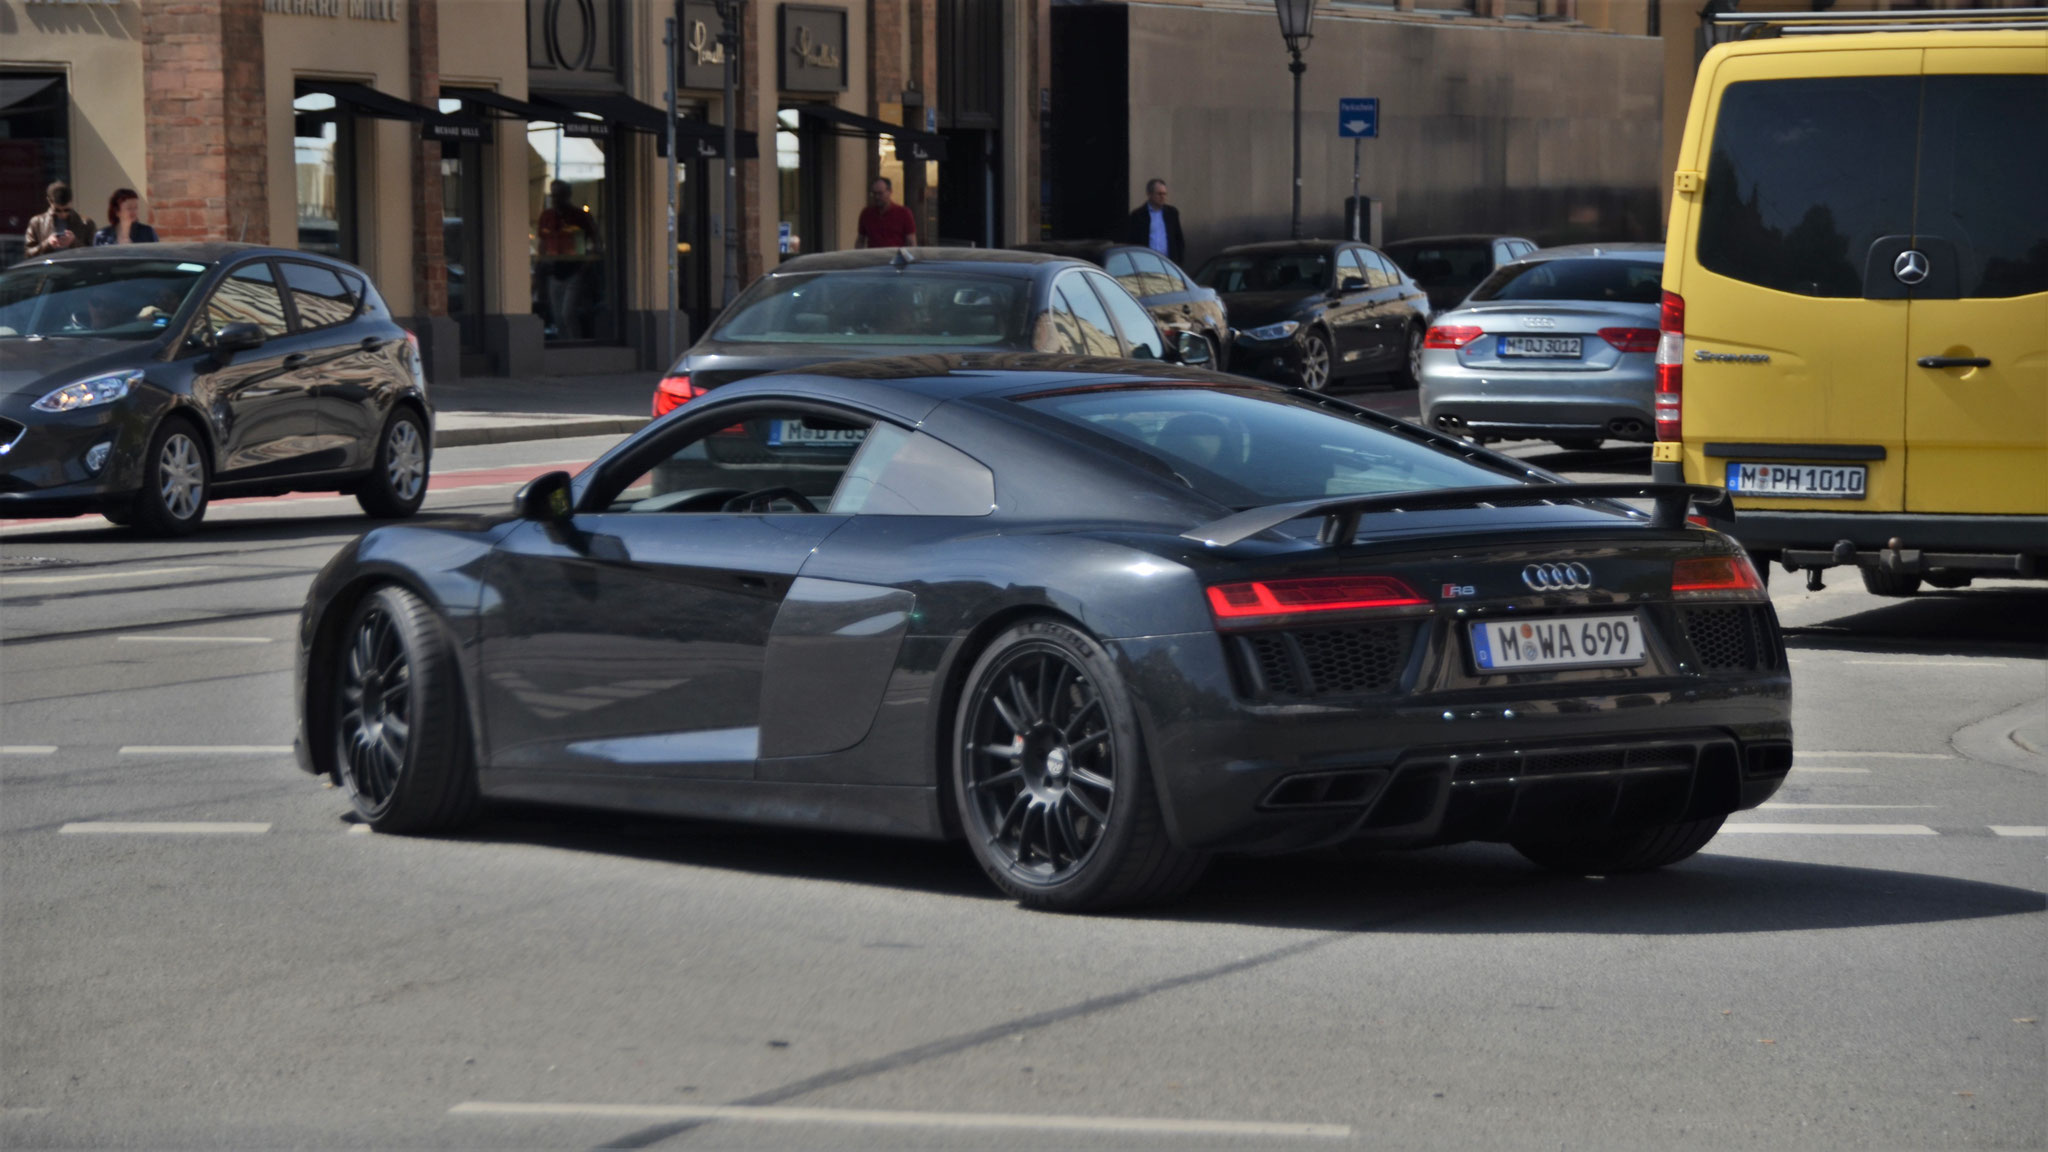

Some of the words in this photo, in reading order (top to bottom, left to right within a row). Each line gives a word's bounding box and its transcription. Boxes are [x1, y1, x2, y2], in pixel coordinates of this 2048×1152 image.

[348, 0, 400, 21] MILLE
[1545, 340, 1578, 352] 3012
[1771, 468, 1800, 490] PH
[1806, 469, 1862, 492] 1010
[1499, 626, 1521, 661] M
[1536, 624, 1576, 659] WA
[1581, 621, 1630, 656] 699
